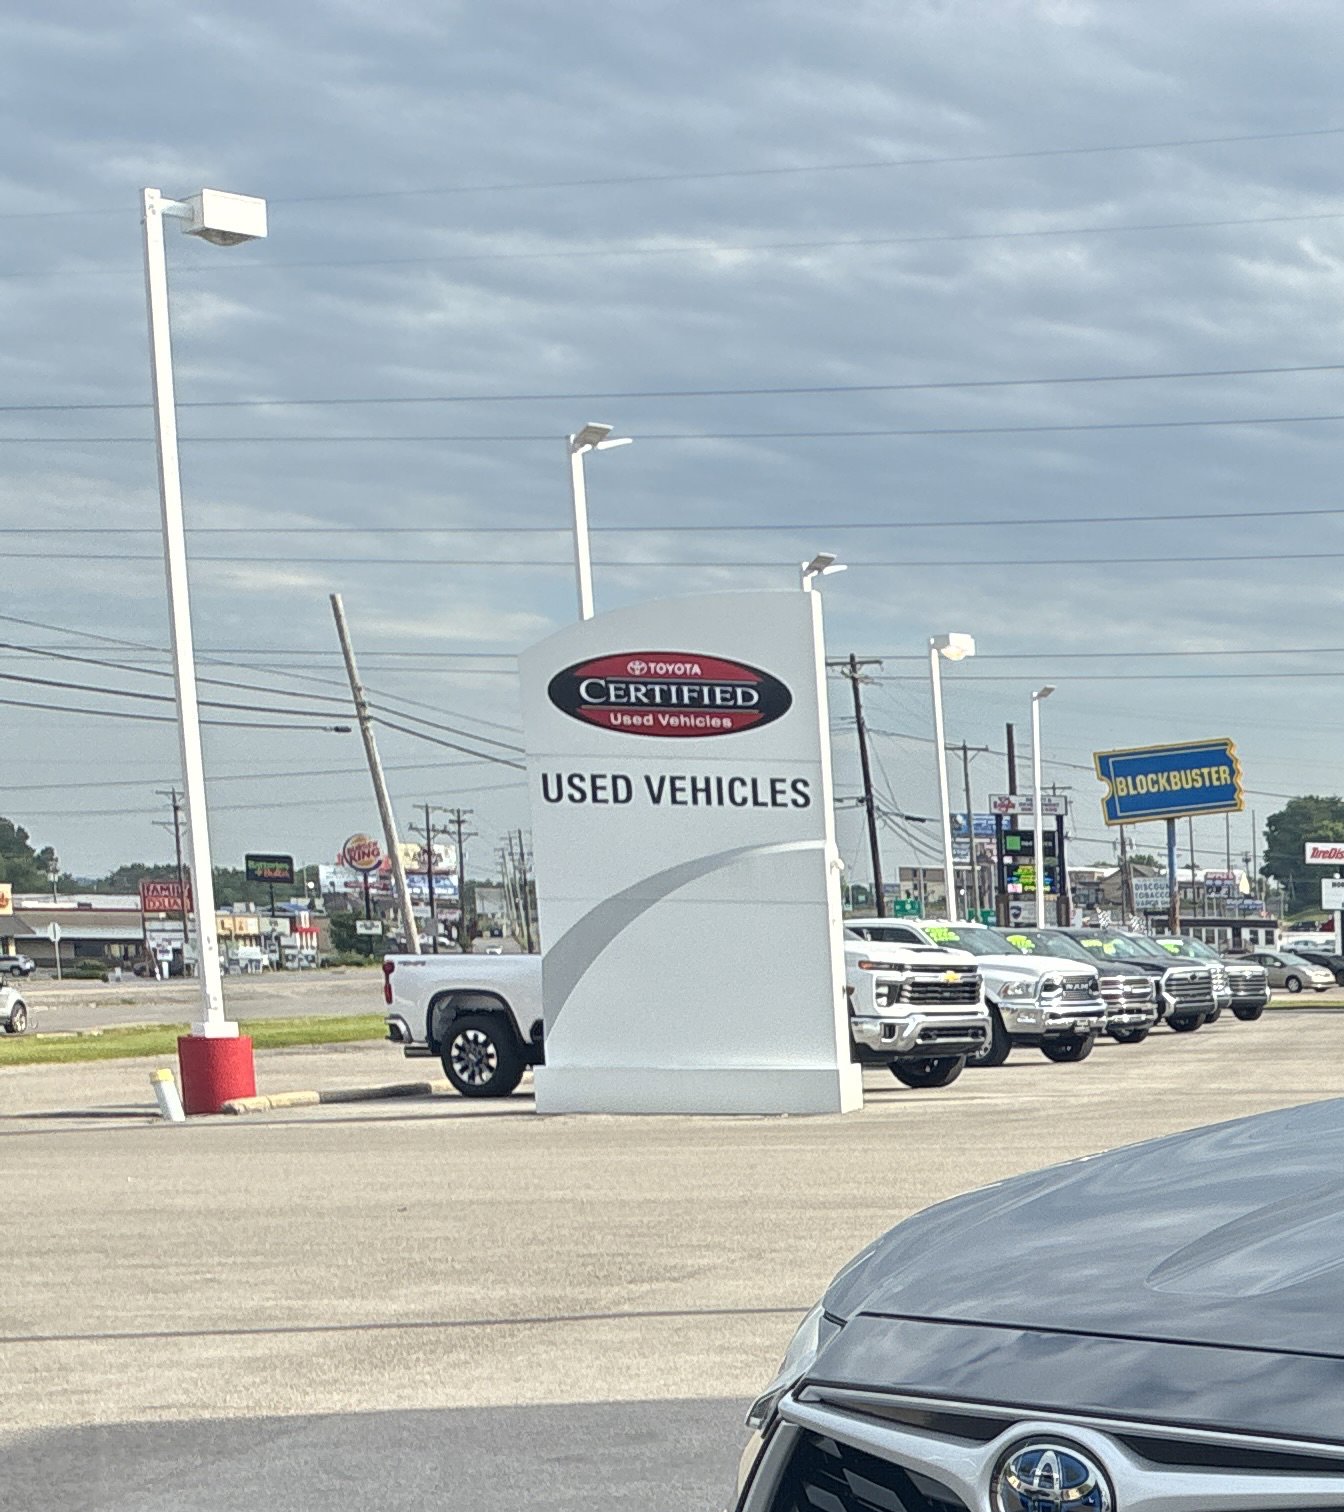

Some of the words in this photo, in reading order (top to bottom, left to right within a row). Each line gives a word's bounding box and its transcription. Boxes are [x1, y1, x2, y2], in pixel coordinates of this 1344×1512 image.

[648, 662, 702, 676] TOYOTA
[579, 678, 760, 707] CERTIFIED
[609, 712, 654, 727] Used
[657, 713, 733, 729] Vehicles
[1115, 765, 1232, 797] BLOCKBUSTER
[541, 773, 633, 805] USED
[643, 775, 811, 809] VEHICLES
[349, 848, 380, 865] KING
[1134, 883, 1170, 891] DISCOUN
